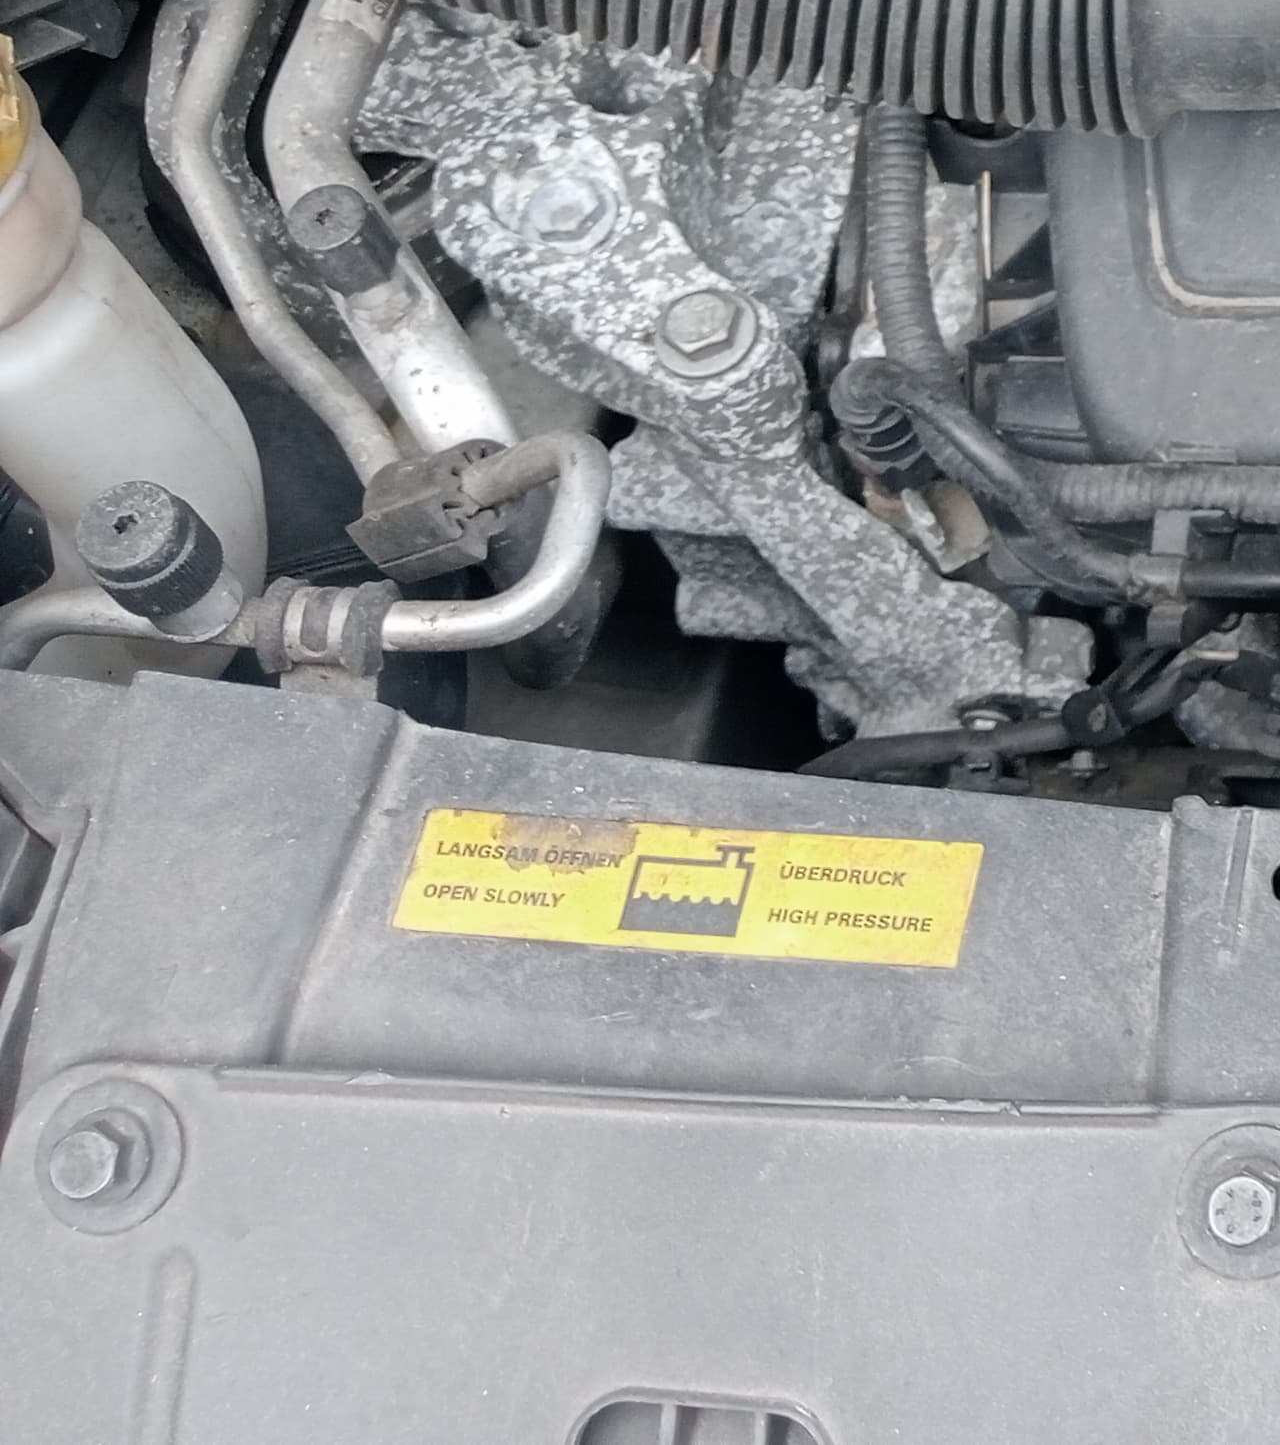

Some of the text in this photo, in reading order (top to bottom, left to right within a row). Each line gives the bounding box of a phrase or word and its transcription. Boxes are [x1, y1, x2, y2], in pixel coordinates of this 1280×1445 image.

[436, 840, 625, 869] LANGSAM ÖFFNEN
[779, 861, 907, 887] ÜBERDRUCK
[423, 883, 566, 908] OPEN SLOWLY
[767, 907, 933, 933] HIGH PRESSURE
